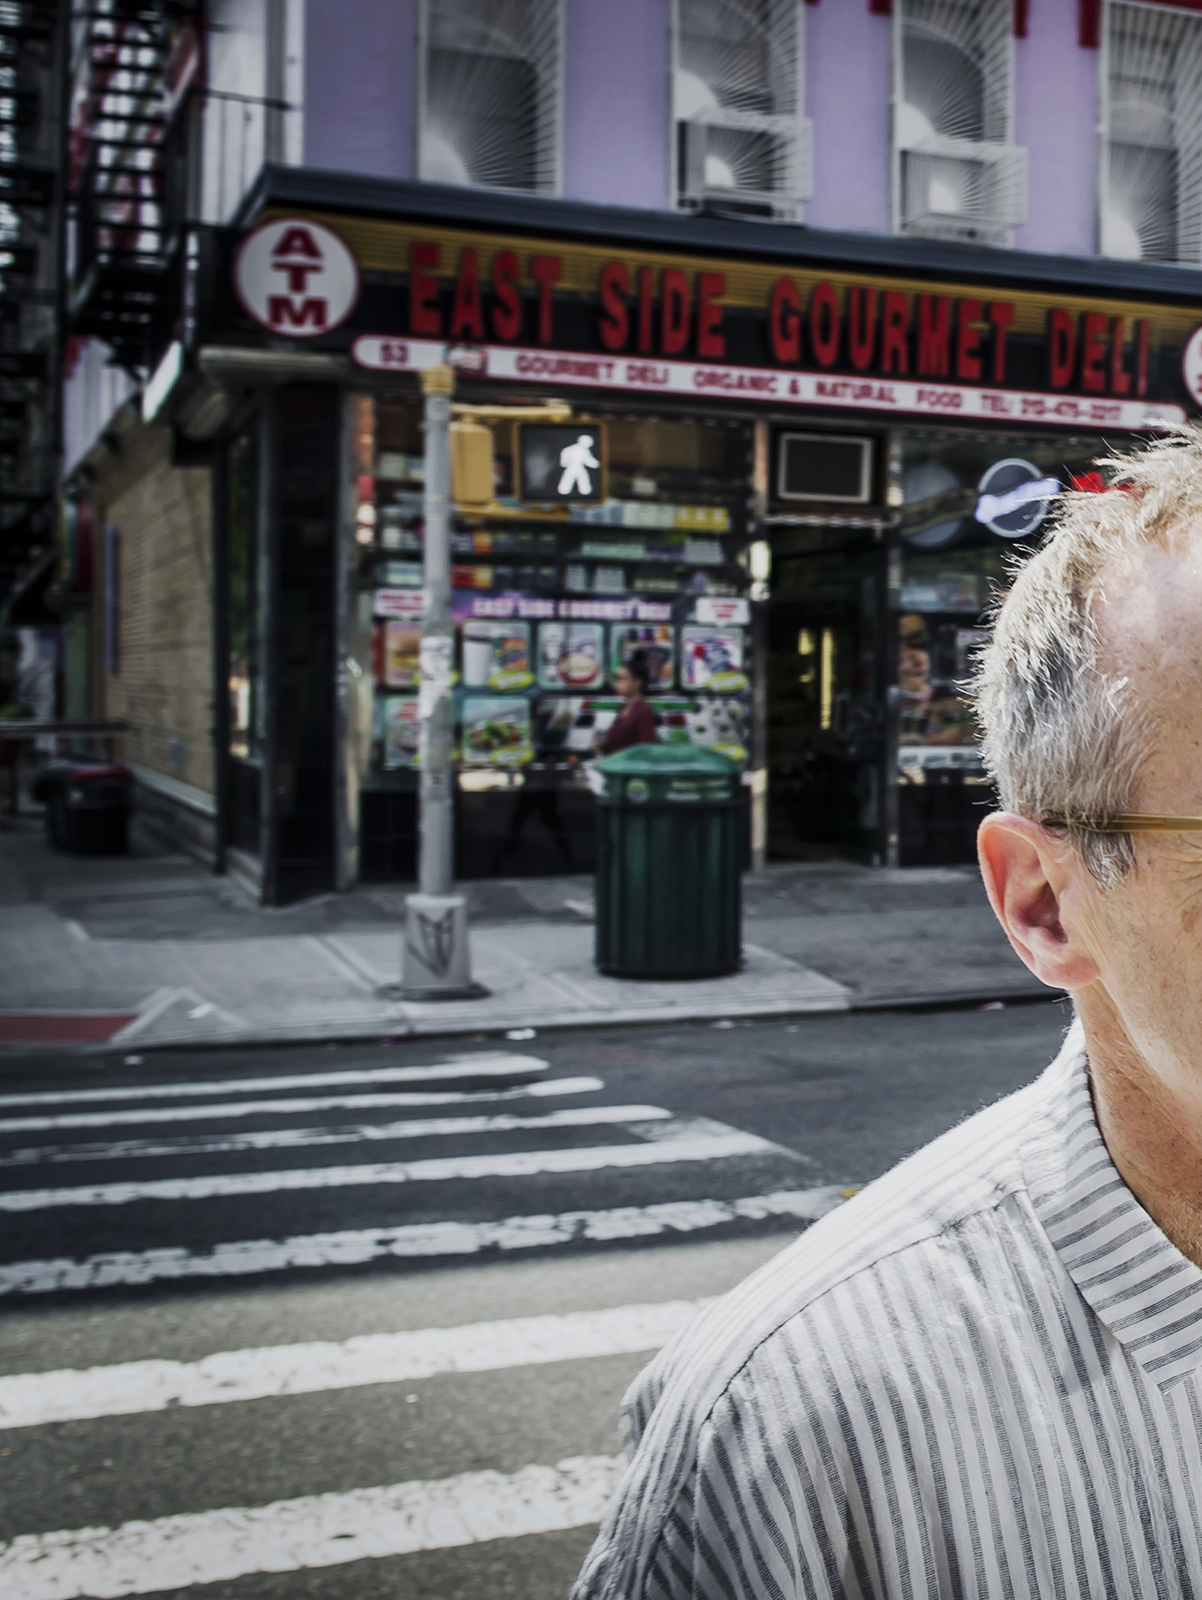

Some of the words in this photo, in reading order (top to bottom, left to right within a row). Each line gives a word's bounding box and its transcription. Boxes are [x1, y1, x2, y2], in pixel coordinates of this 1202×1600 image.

[268, 226, 329, 327] ATM
[408, 241, 563, 344] EAST
[601, 260, 726, 357] SIDE
[770, 275, 1014, 382] GOURMET
[1049, 308, 1151, 397] DELI
[514, 352, 615, 380] GOURMET
[625, 363, 669, 385] DELI
[694, 369, 778, 394] ORGANIC
[815, 380, 897, 404] NATURAL
[915, 388, 964, 409] FOOD
